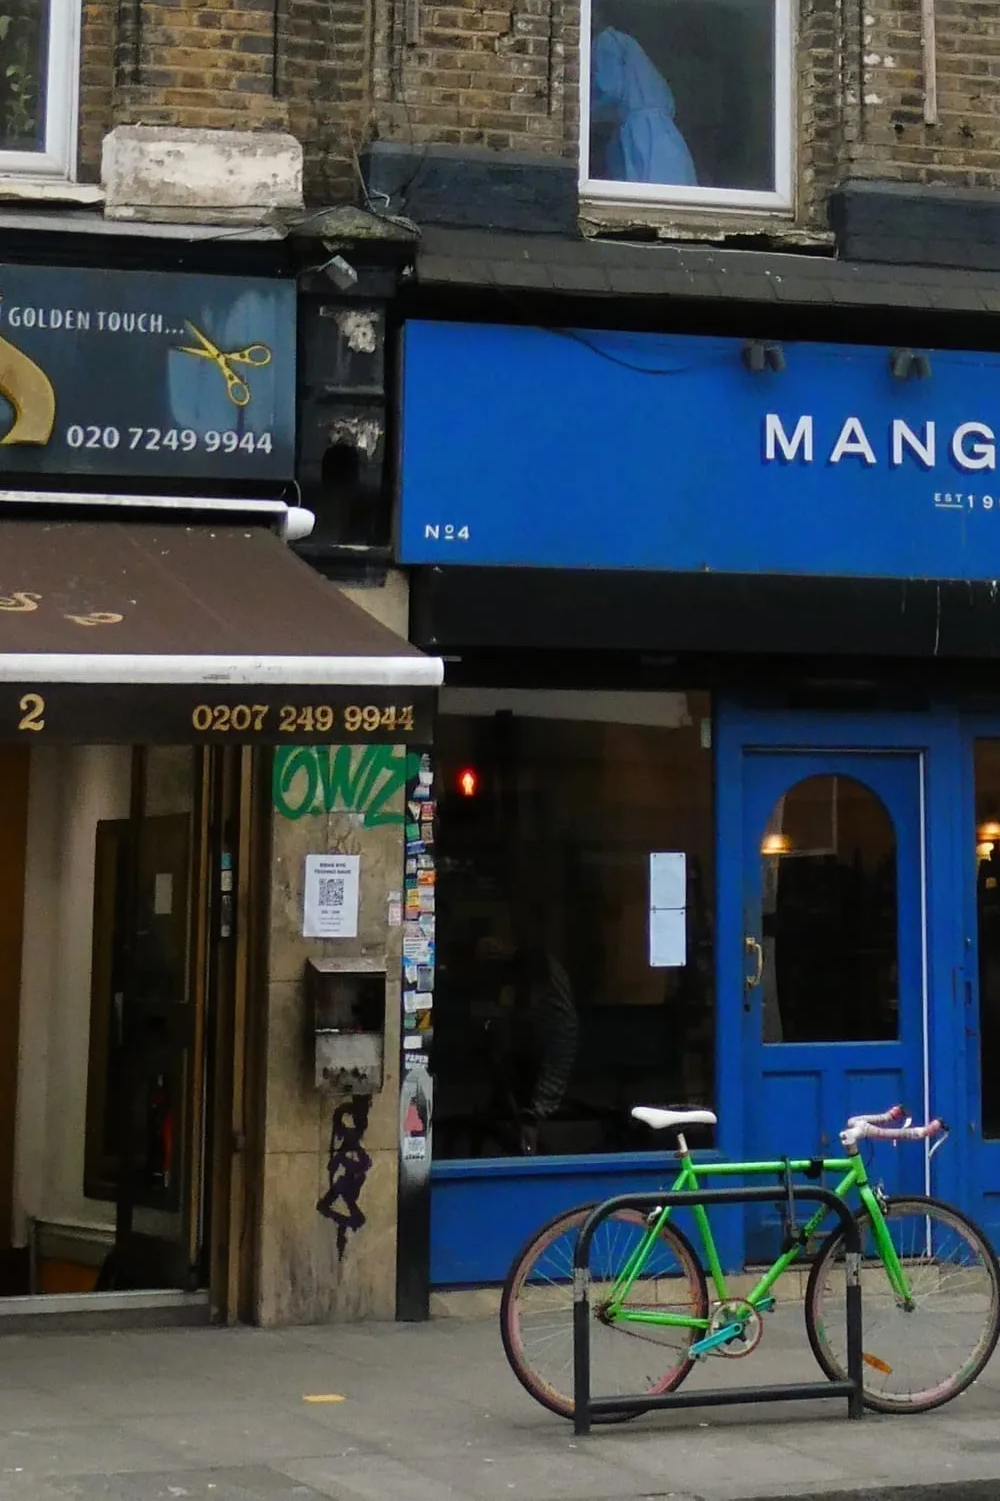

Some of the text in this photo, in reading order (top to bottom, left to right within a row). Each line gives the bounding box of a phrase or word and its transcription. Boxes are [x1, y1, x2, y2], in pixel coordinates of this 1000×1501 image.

[8, 306, 91, 330] GOLDEN
[66, 424, 273, 454] 020 7249 9944
[934, 492, 963, 508] EST
[18, 693, 415, 732] 2 0207 249 9944
